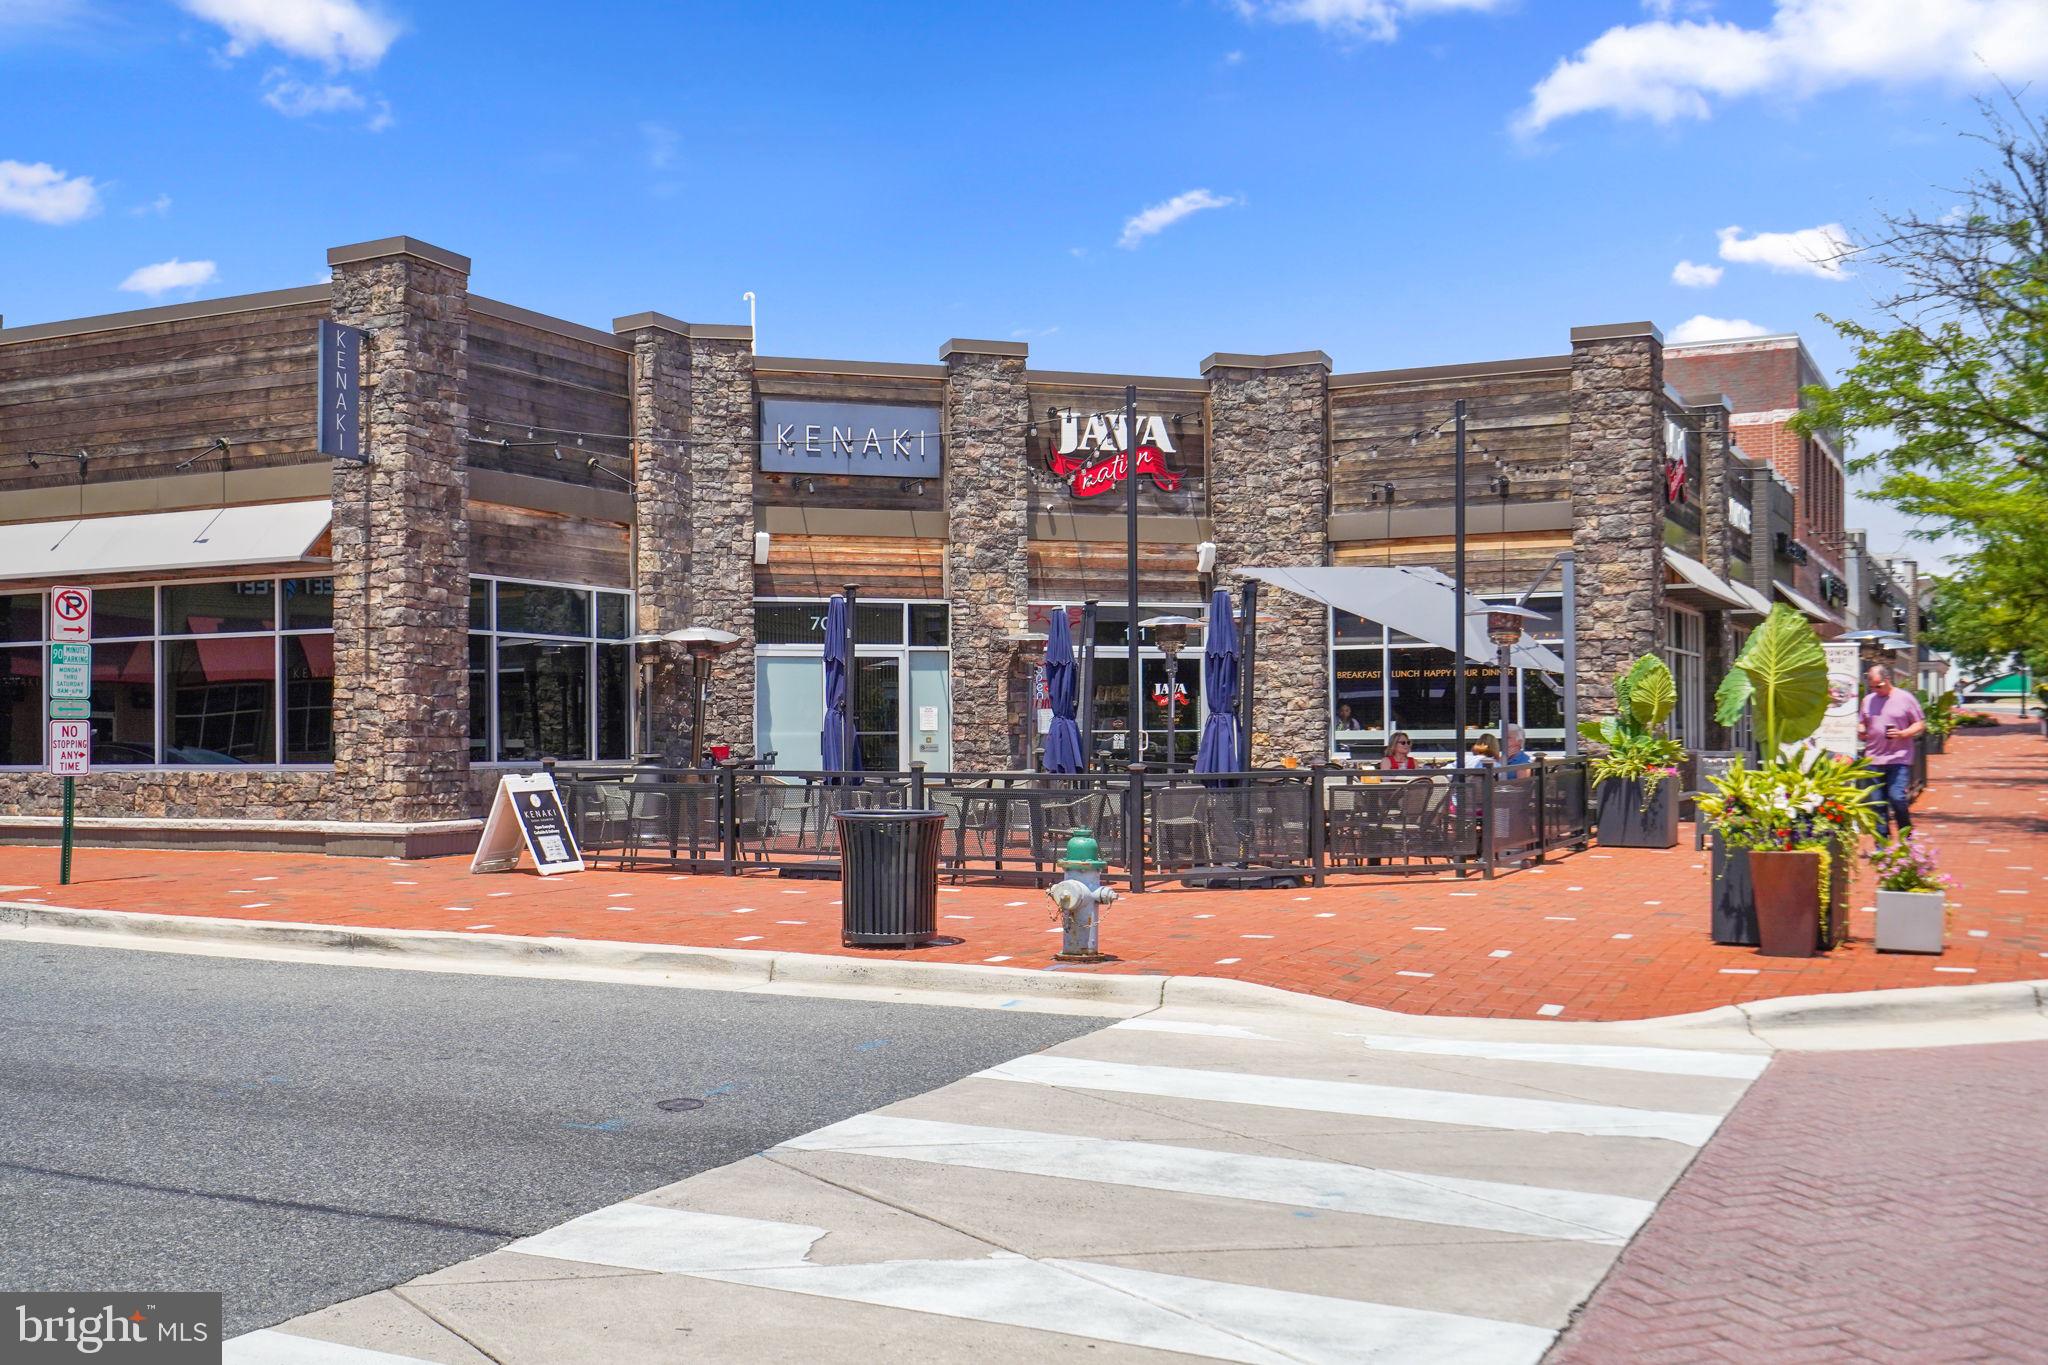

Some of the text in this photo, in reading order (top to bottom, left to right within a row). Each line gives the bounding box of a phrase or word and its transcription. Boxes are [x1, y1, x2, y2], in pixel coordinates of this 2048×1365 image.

[335, 329, 348, 451] KENAKI
[1057, 411, 1177, 454] JAVA
[777, 423, 925, 457] KENAKI
[1082, 449, 1154, 490] natin
[1123, 628, 1146, 641] 11
[52, 648, 63, 660] 90
[65, 646, 87, 654] MINUTE
[63, 655, 88, 663] PARKING
[1336, 668, 1514, 680] BREAKFAST LUNCH HAPPY HUR DINNR
[61, 726, 78, 738] NO
[52, 739, 87, 749] STOPPING
[60, 750, 79, 760] ANY
[60, 762, 81, 771] TIME
[523, 808, 557, 819] KENAKI
